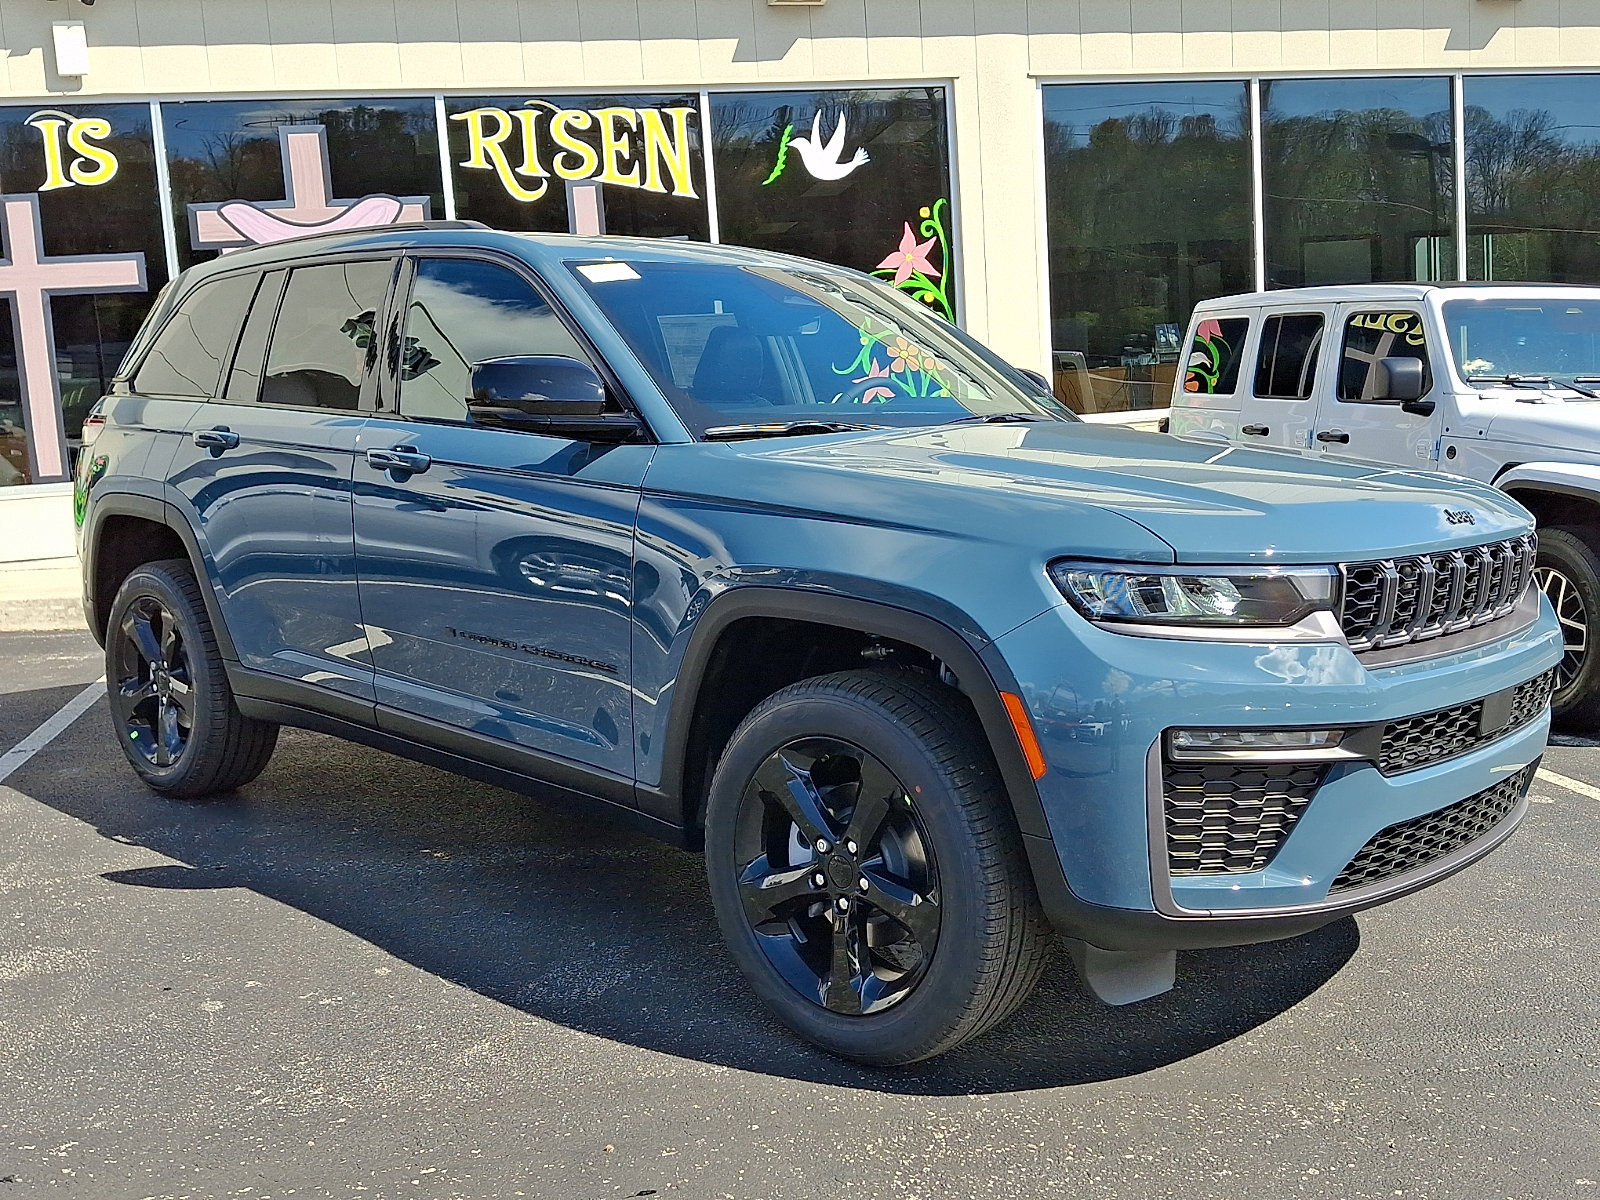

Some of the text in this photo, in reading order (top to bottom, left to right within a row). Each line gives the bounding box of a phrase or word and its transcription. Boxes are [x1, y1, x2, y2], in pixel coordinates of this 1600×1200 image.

[24, 100, 700, 202] IS RISEN
[1443, 509, 1476, 526] Jeep
